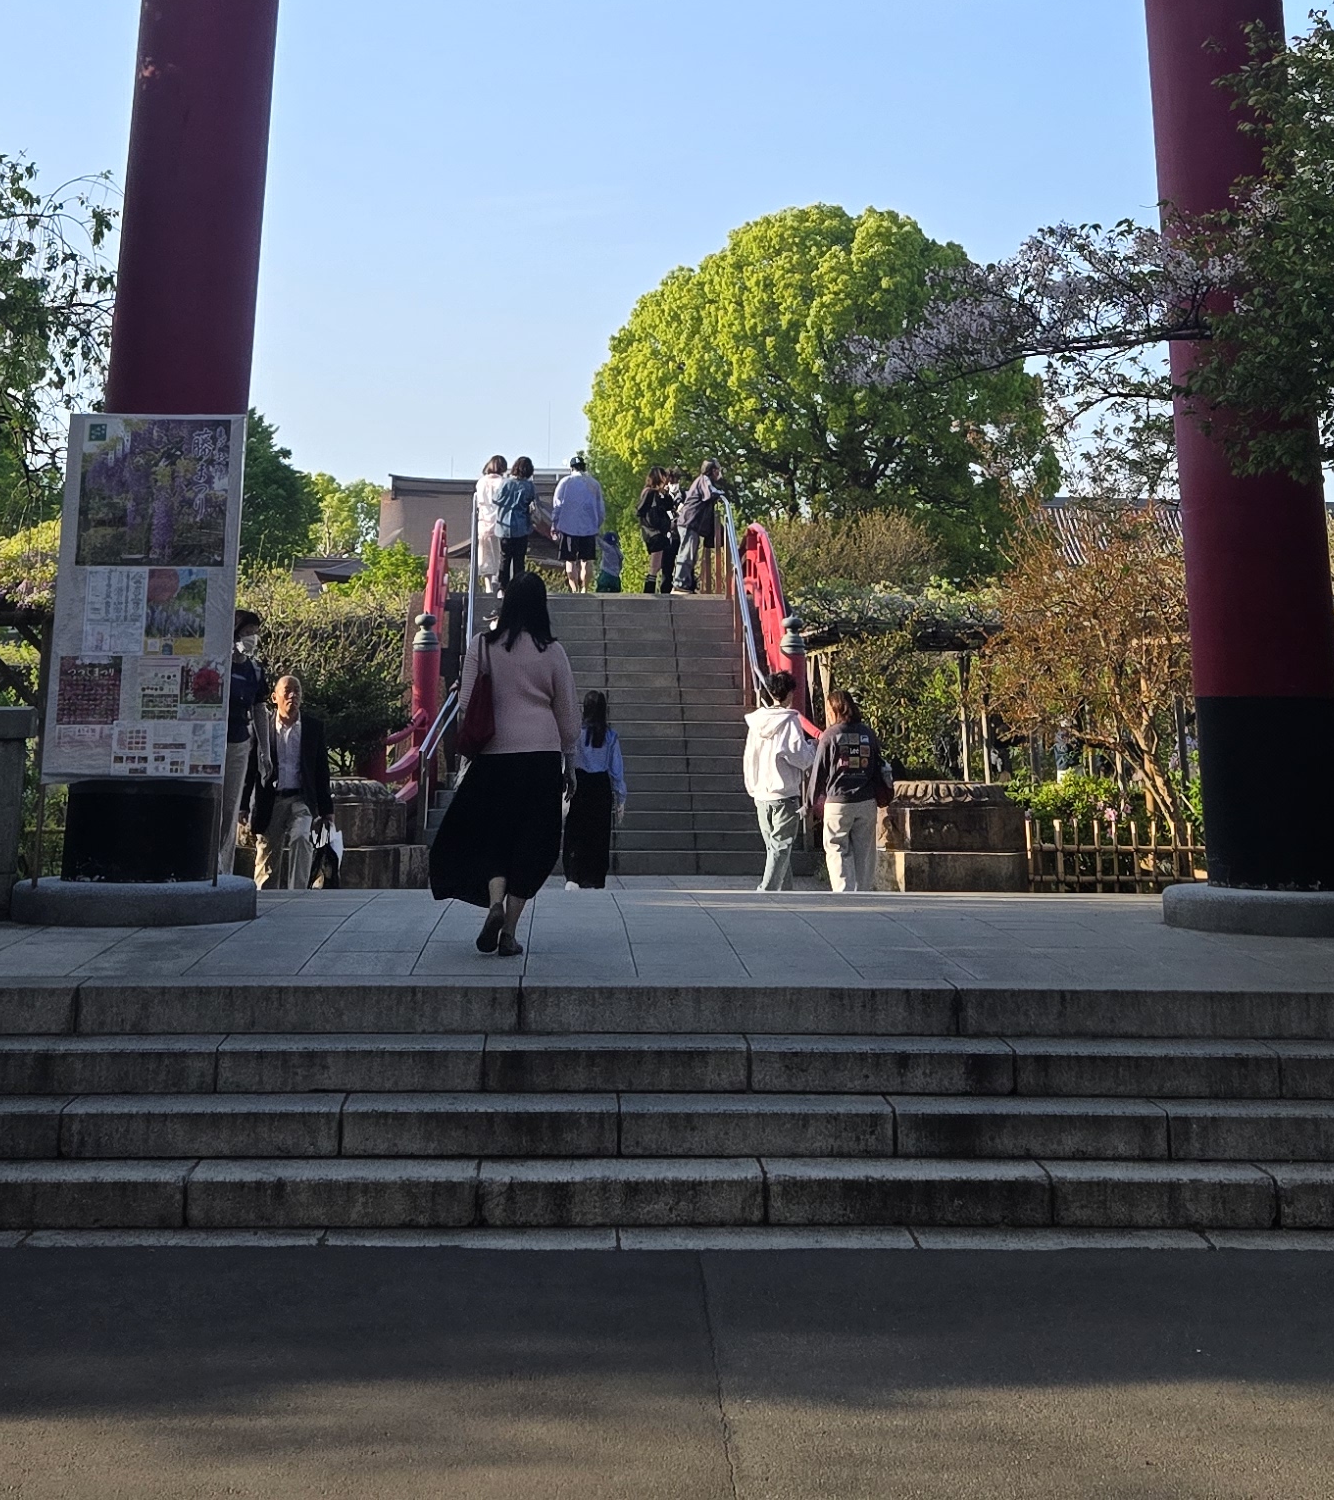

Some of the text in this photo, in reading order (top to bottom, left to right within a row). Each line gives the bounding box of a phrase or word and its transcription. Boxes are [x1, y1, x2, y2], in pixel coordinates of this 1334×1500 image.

[191, 428, 215, 521] 藤まつり
[67, 668, 115, 676] つつじまつり
[849, 747, 860, 755] Lee
